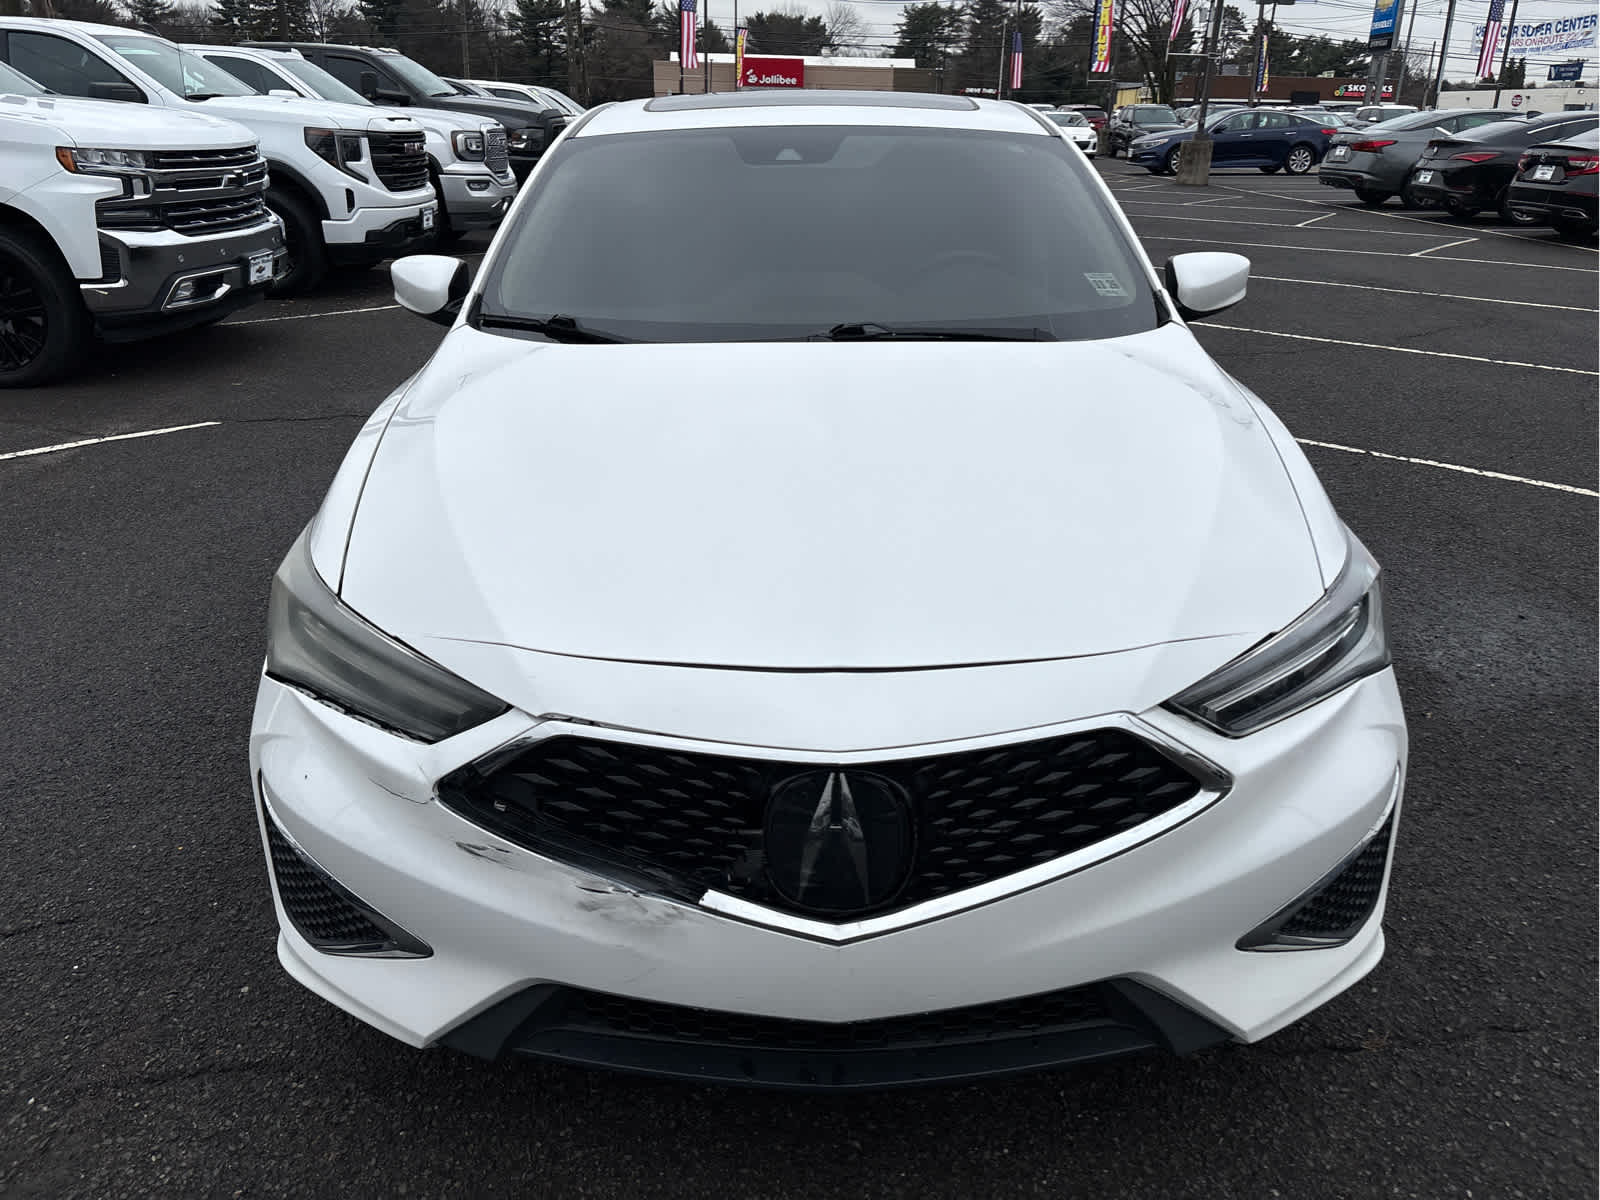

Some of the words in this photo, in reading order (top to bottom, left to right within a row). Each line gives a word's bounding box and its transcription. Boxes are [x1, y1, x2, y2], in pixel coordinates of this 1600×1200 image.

[1500, 26, 1519, 38] CR
[1555, 14, 1598, 33] CENTER
[1538, 34, 1564, 46] ROUTE
[759, 74, 797, 84] Jollibee
